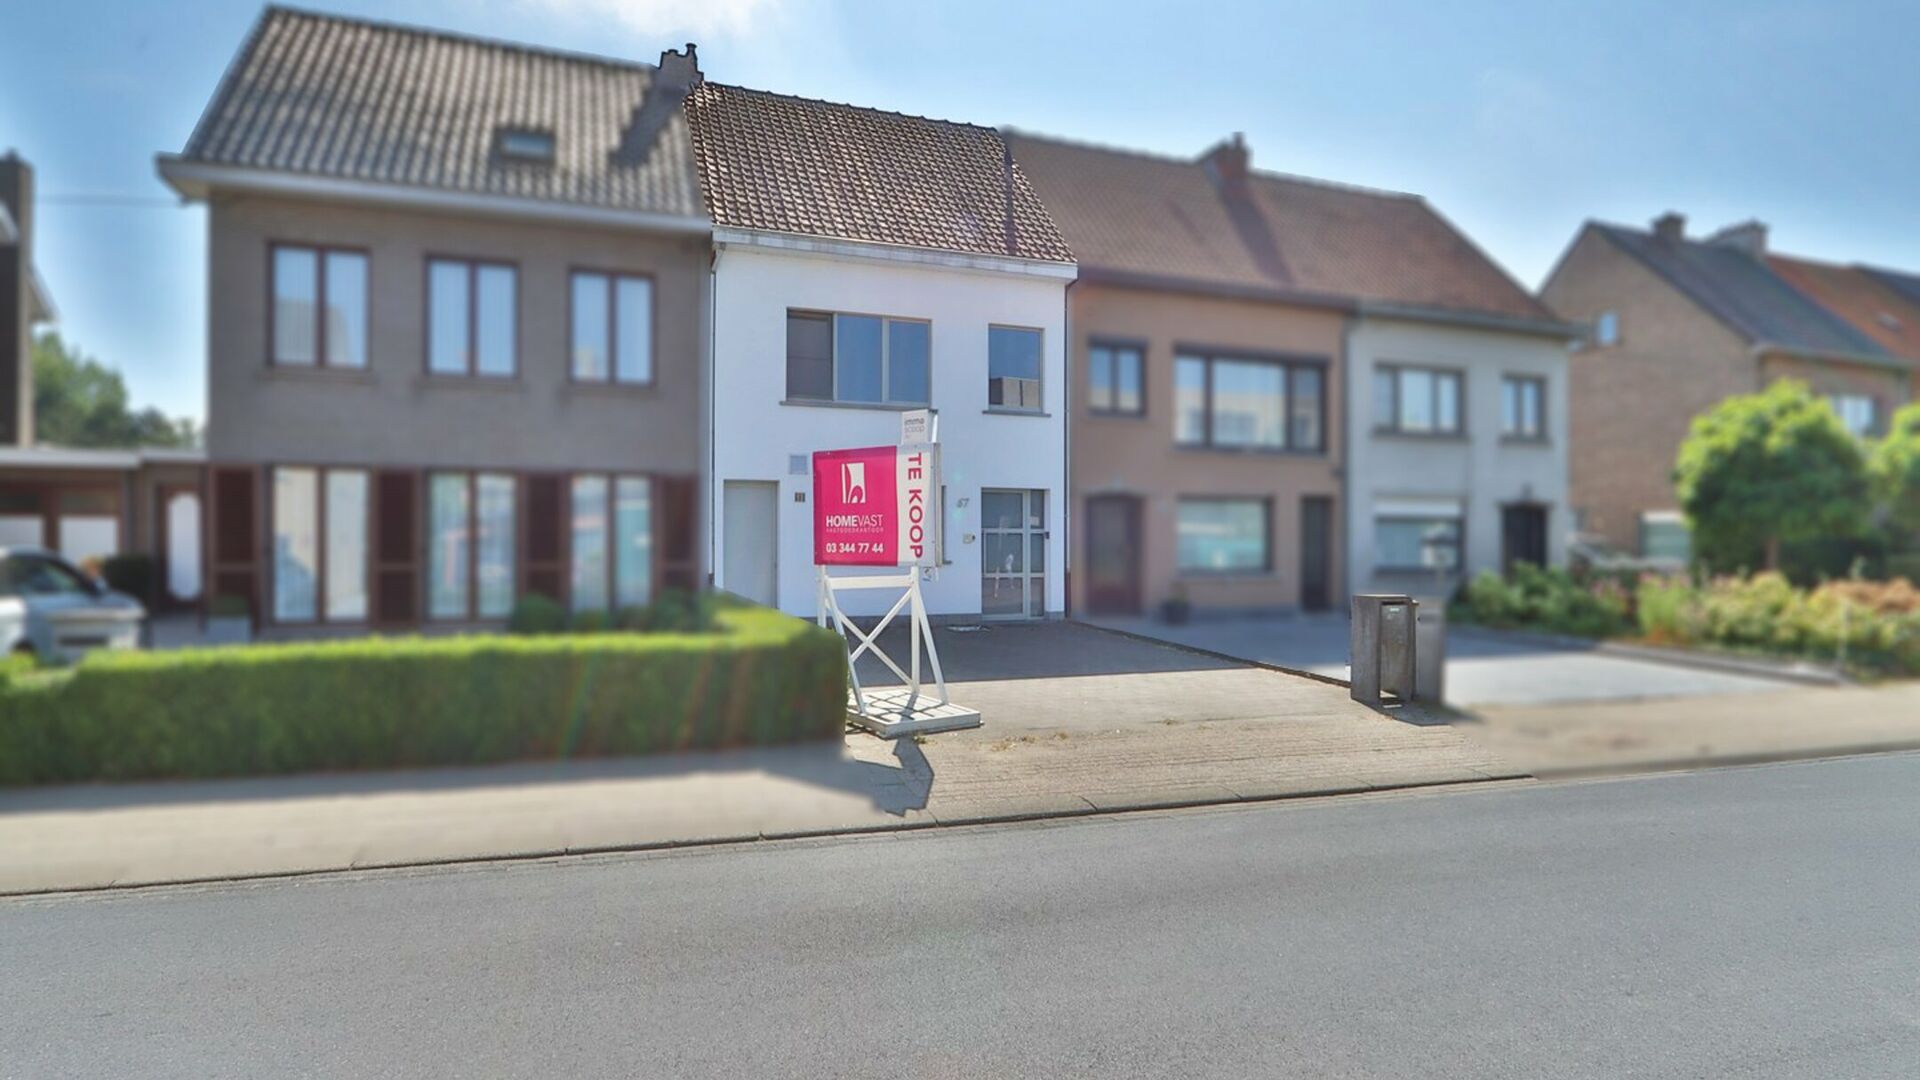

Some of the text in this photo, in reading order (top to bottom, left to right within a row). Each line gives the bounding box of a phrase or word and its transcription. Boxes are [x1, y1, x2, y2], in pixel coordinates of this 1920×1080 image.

[907, 452, 924, 558] TE KOOP
[825, 514, 884, 528] HOMEVAST
[825, 542, 884, 553] 03 344 77 44
